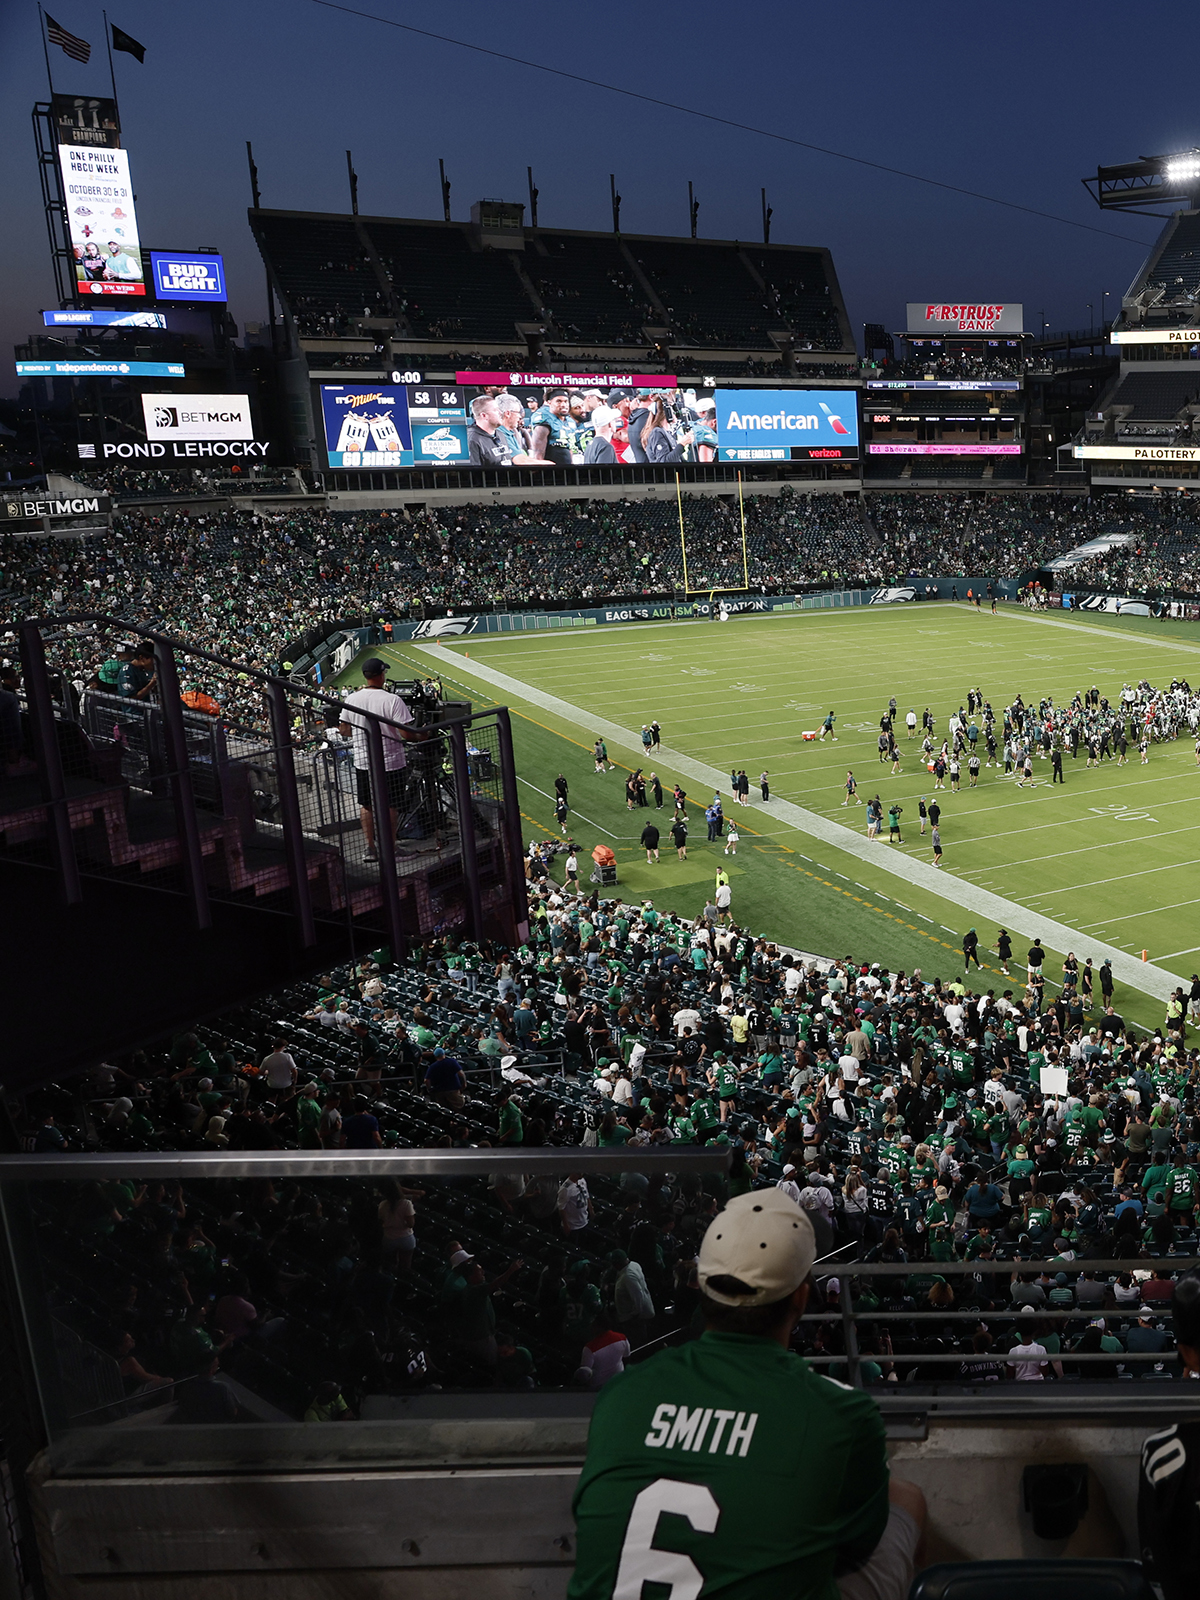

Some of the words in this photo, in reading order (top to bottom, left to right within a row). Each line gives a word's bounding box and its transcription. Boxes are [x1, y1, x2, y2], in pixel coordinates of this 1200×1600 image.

[72, 131, 107, 142] CHAMPIONS
[69, 151, 86, 161] ONE
[88, 152, 115, 163] PHILLY
[71, 162, 94, 172] HBCU
[96, 164, 119, 174] WEEK
[69, 184, 102, 195] OCTOBER
[102, 187, 112, 196] 30
[120, 188, 127, 197] 31
[168, 263, 208, 278] BUD
[162, 275, 216, 291] LIGHT
[958, 320, 995, 331] BANK
[1169, 332, 1183, 341] PA
[56, 363, 118, 374] Independence
[392, 371, 421, 384] 0:00
[524, 374, 562, 386] Lincoln
[563, 374, 608, 386] Financial
[609, 375, 633, 386] Field
[346, 392, 383, 408] Miller
[414, 391, 430, 404] 58
[442, 392, 457, 405] 36
[181, 412, 242, 423] BETMGM
[726, 410, 819, 430] American
[103, 443, 166, 458] POND
[173, 442, 270, 458] LEHOCKY
[808, 449, 842, 458] verizon
[1134, 449, 1148, 458] PA
[1150, 450, 1196, 459] LOTTERY
[342, 451, 361, 466] GO
[362, 451, 401, 466] BIRDS
[24, 498, 99, 517] BETMGM
[697, 600, 763, 614] FODATION
[954, 1061, 966, 1072] 98
[1066, 1134, 1082, 1147] 26
[847, 1141, 861, 1155] 33
[1173, 1180, 1191, 1194] 26
[872, 1197, 887, 1211] 33
[903, 1208, 909, 1220] 1
[567, 1303, 583, 1315] 27
[644, 1403, 758, 1457] SMITH
[612, 1477, 720, 1600] 6
